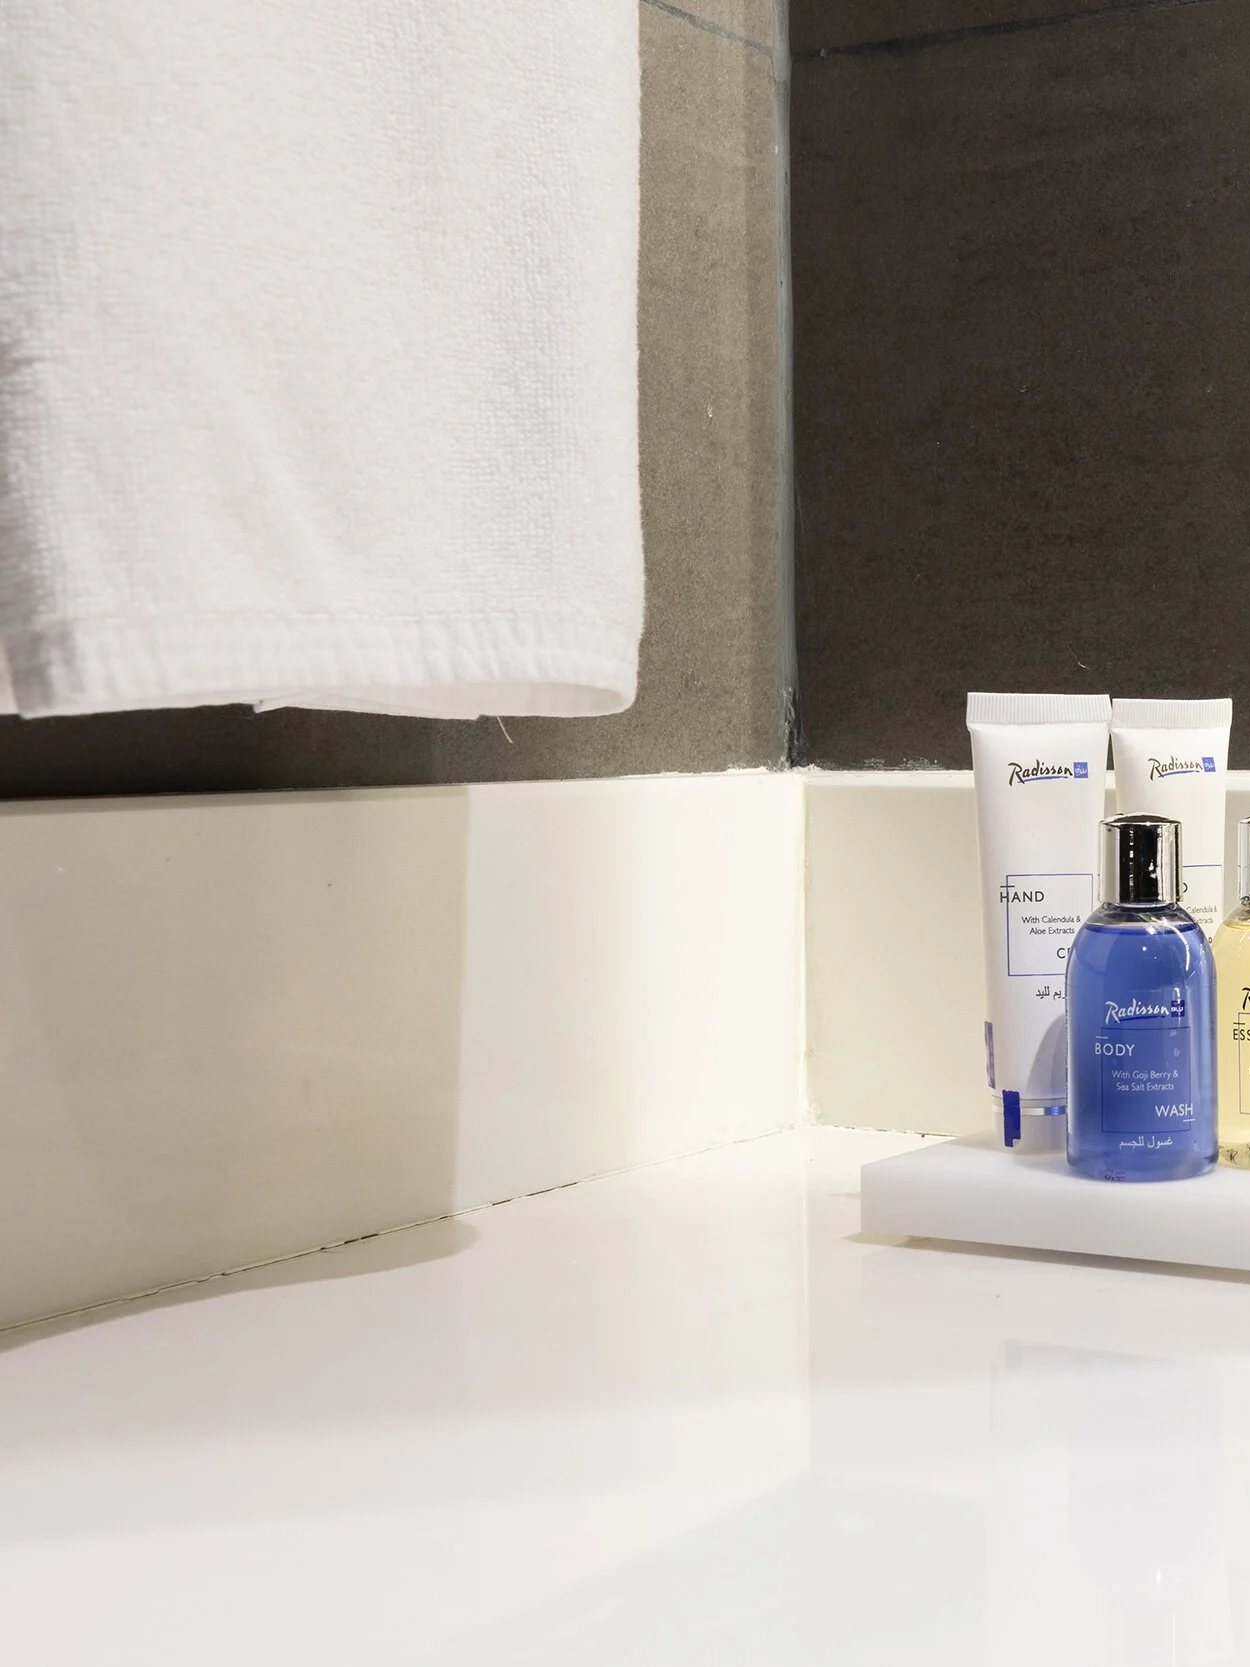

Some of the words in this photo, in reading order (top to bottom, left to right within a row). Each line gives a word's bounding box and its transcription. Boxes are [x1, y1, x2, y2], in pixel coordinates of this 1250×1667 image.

[1008, 759, 1073, 786] Radisson
[1148, 756, 1204, 781] Radisson
[1000, 890, 1045, 903] HAND
[1021, 915, 1040, 925] With
[1041, 915, 1073, 925] Calendula
[1074, 916, 1081, 924] &
[1029, 926, 1047, 935] Aloe
[1048, 926, 1075, 935] Extracts
[1105, 998, 1170, 1025] Radisson
[1095, 1043, 1135, 1056] BODY
[1112, 1069, 1130, 1079] With
[1132, 1070, 1149, 1080] Goji
[1150, 1070, 1172, 1081] Berry
[1173, 1070, 1179, 1078] &
[1116, 1082, 1129, 1091] Sea
[1131, 1082, 1145, 1091] Salt
[1146, 1082, 1174, 1091] Extracts
[1154, 1104, 1193, 1117] WASH
[1119, 1136, 1145, 1151] للجسم
[1147, 1137, 1173, 1150] غسول
